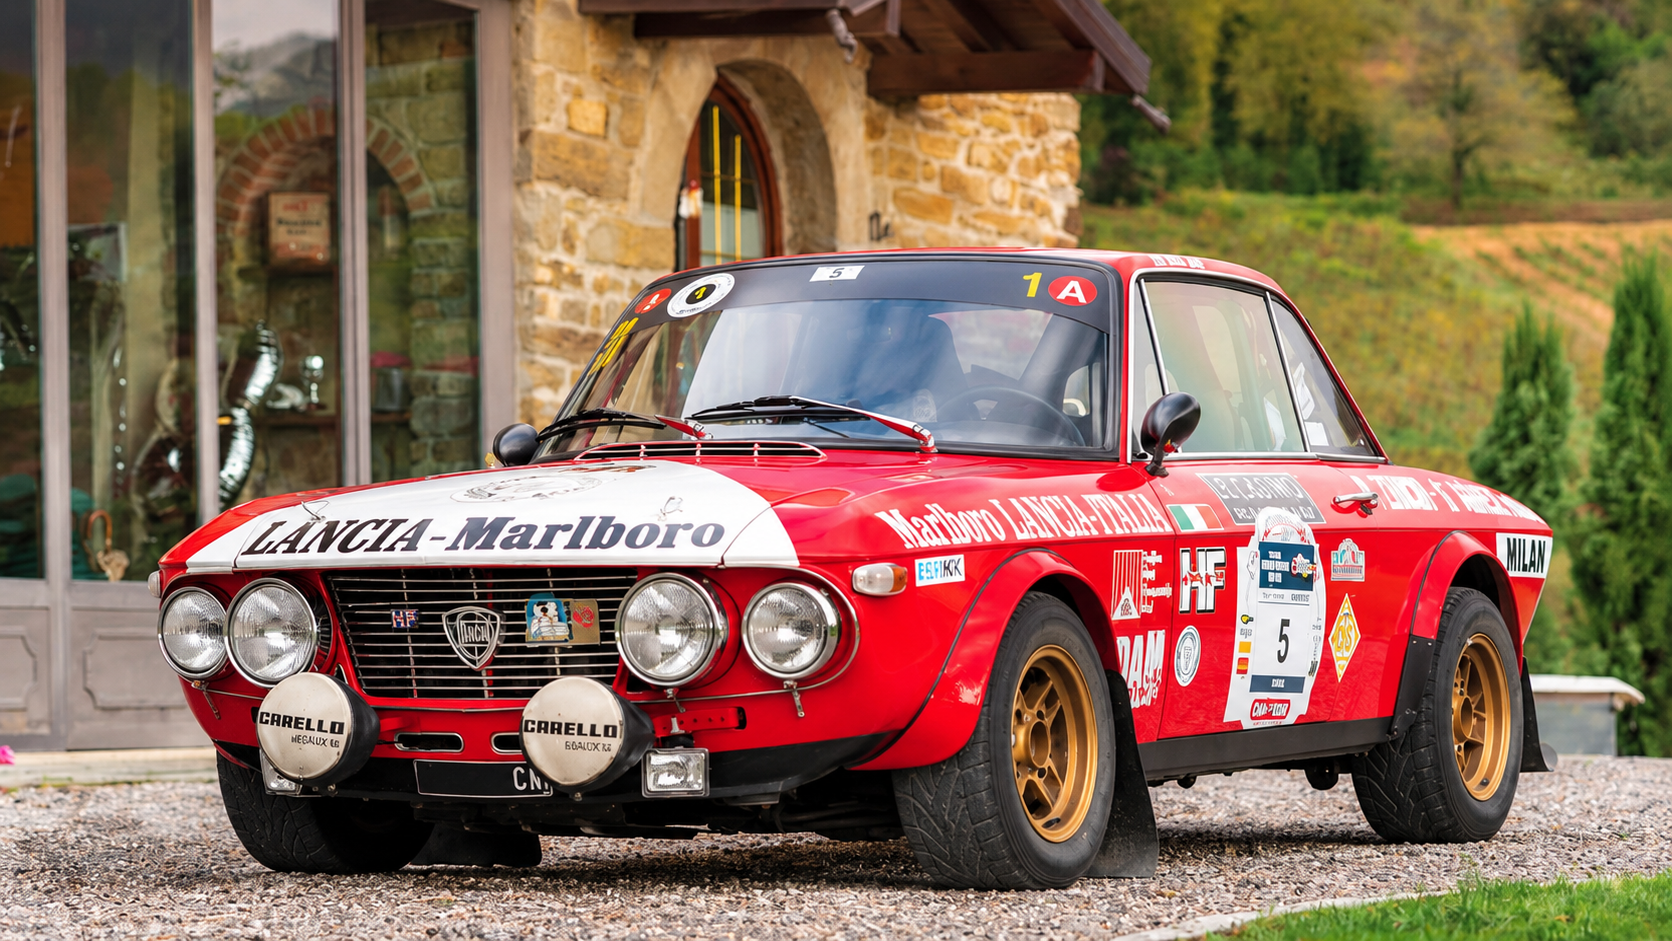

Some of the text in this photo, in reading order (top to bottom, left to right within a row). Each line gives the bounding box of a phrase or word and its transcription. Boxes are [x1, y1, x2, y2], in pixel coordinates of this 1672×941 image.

[829, 267, 845, 279] 5
[1023, 272, 1042, 298] 1
[1056, 280, 1087, 304] A
[241, 515, 725, 557] LANCIA-Marlboro
[874, 499, 1007, 549] Marlboro
[1506, 537, 1546, 574] MILAN
[1179, 546, 1227, 614] HF
[1276, 618, 1291, 664] 5
[259, 711, 345, 735] CARELLO
[523, 719, 618, 738] CARELLO
